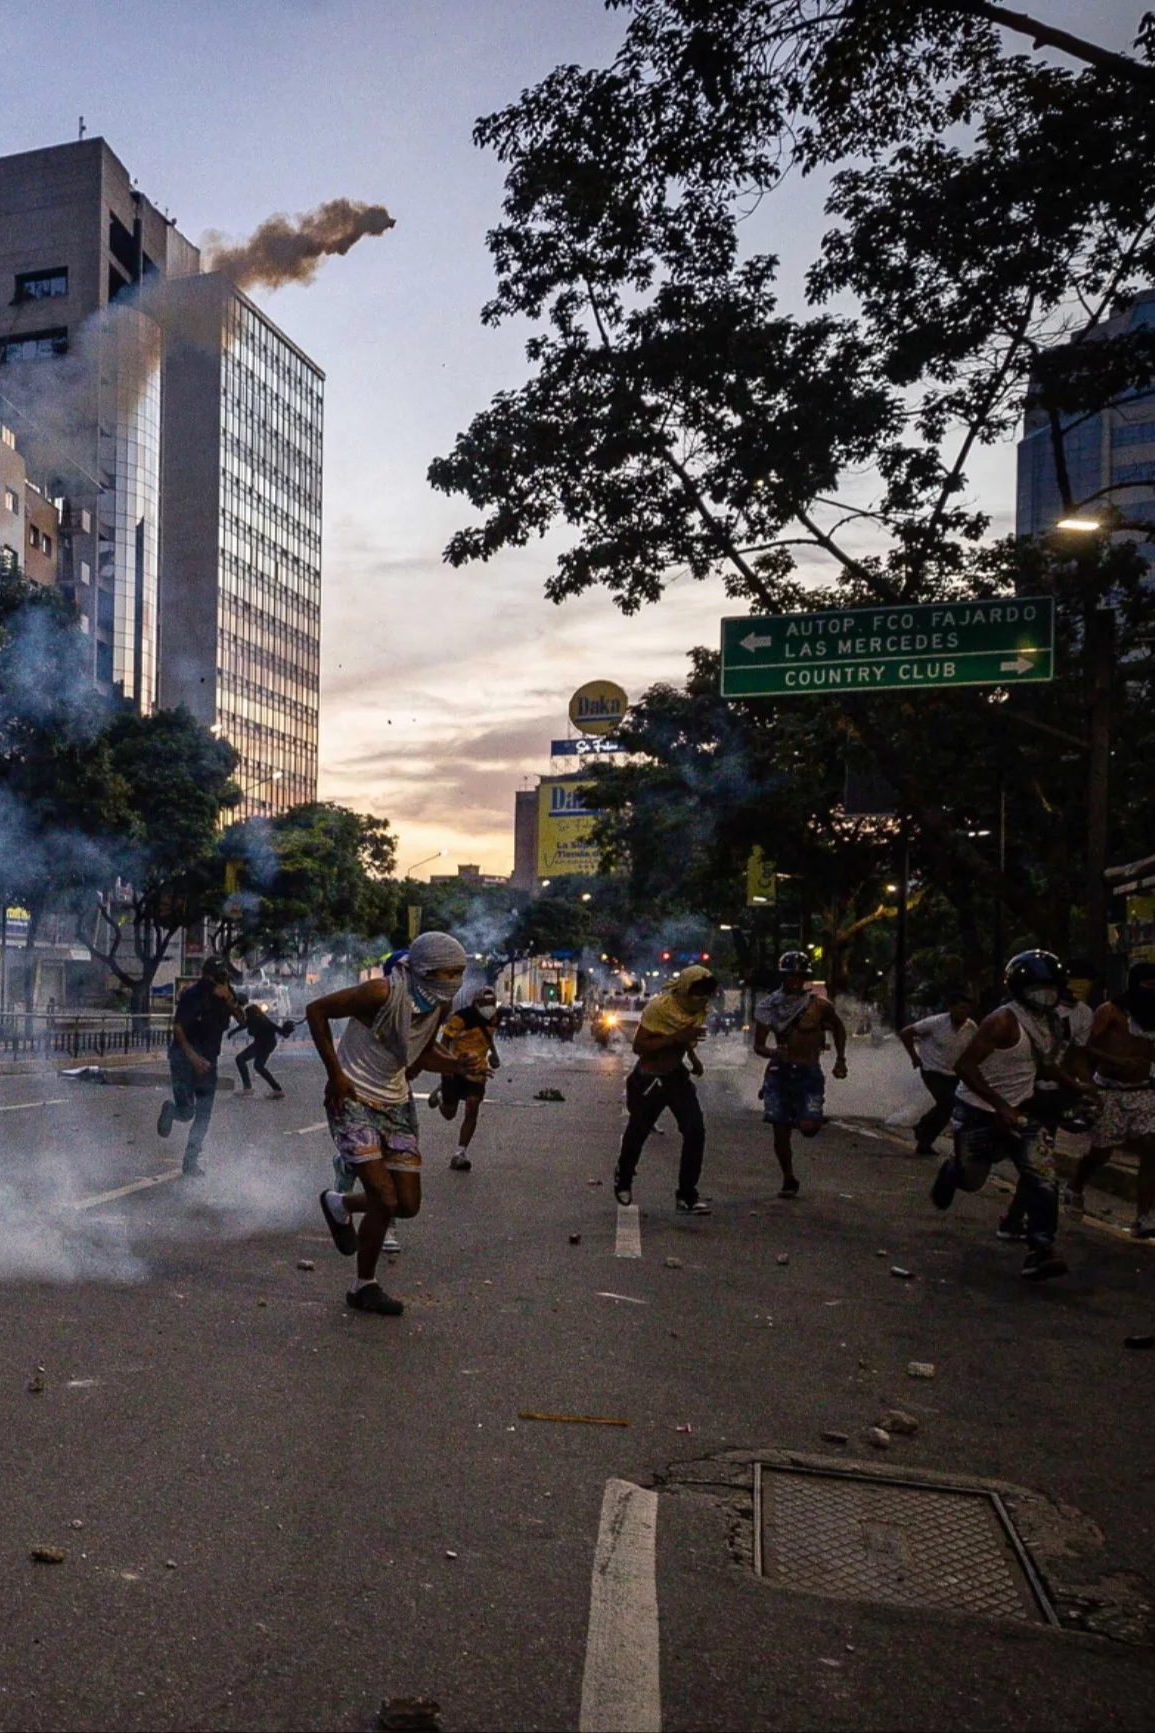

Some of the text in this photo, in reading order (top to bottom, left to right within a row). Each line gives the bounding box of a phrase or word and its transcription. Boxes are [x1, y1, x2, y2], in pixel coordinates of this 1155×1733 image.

[785, 618, 862, 638] AUTOP.
[931, 605, 1037, 627] FAJARDO
[785, 632, 959, 659] LAS MERCEDES
[785, 661, 956, 687] COUNTRY CLUB
